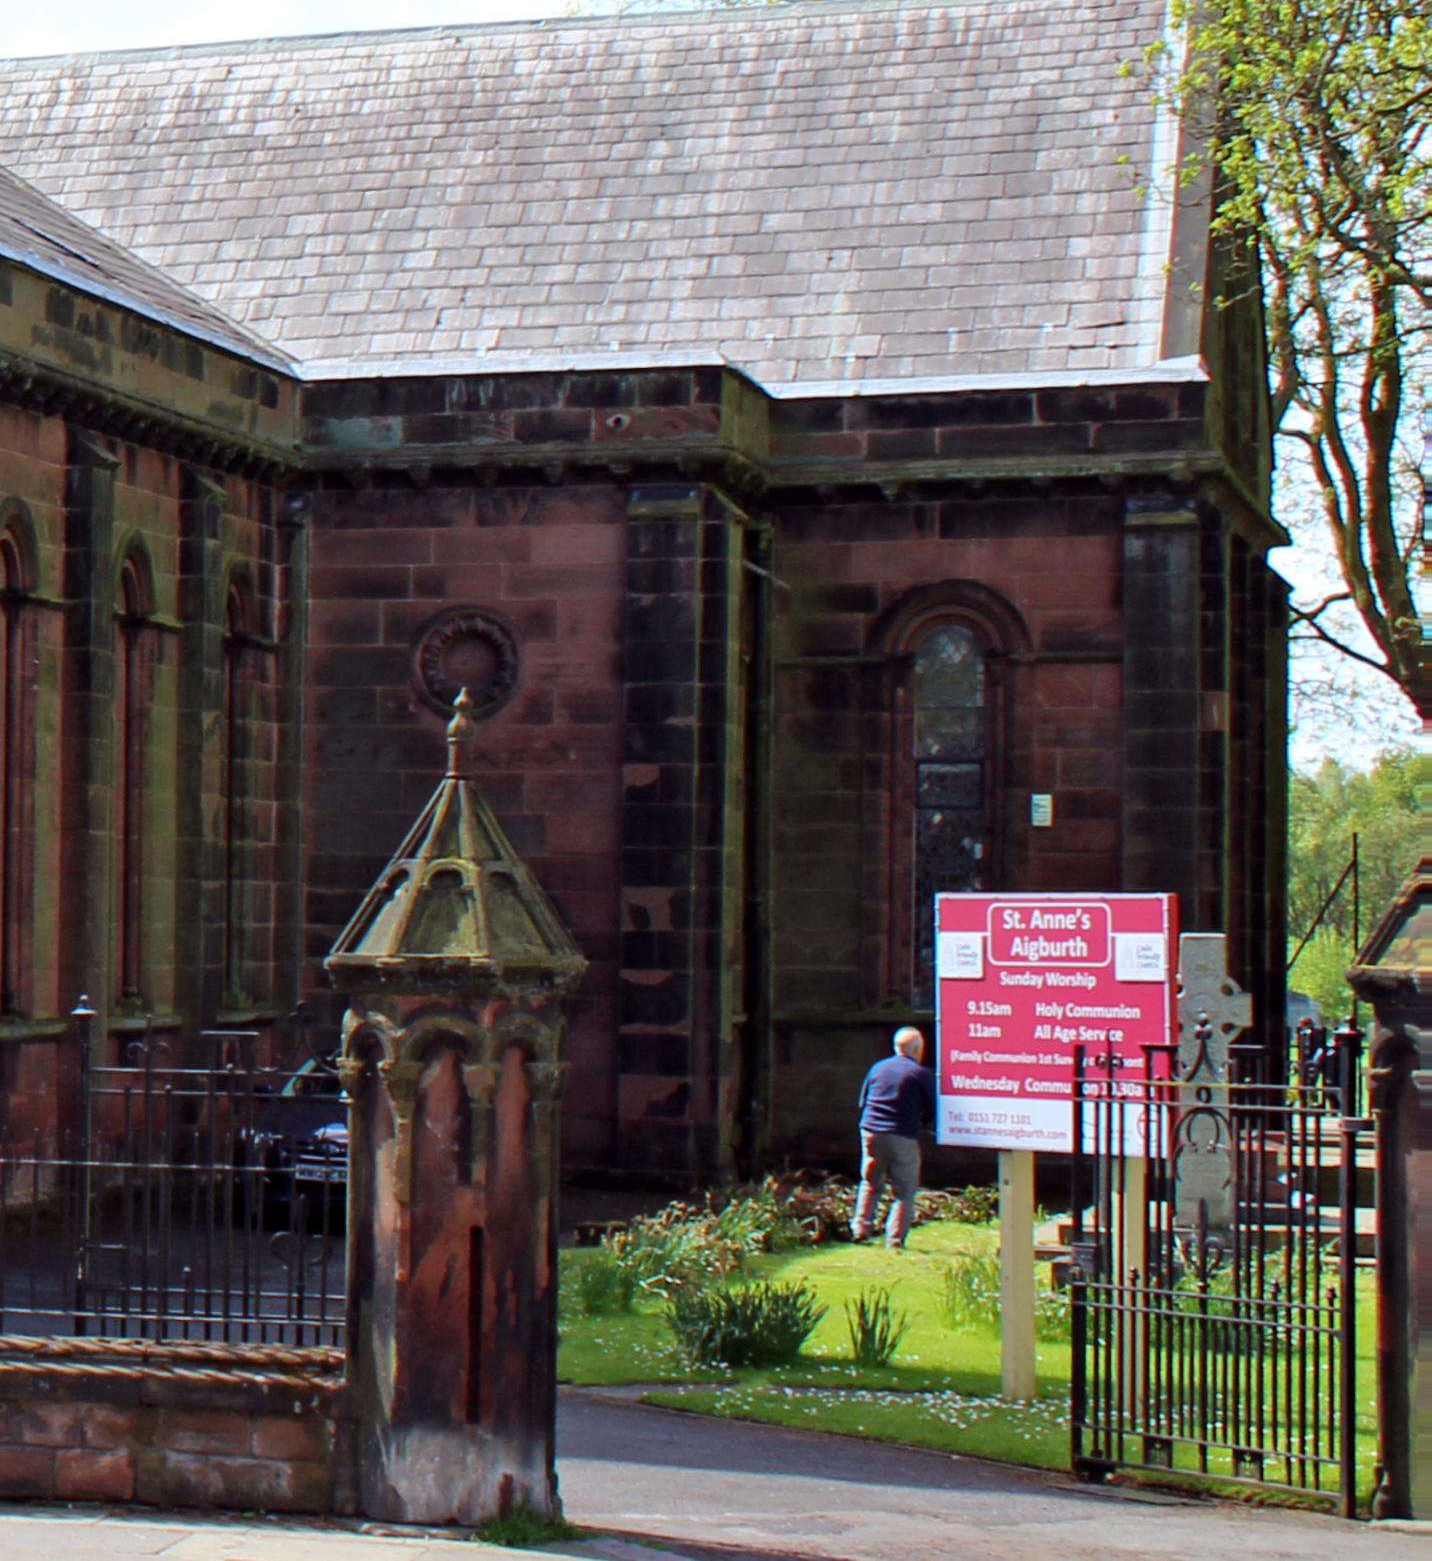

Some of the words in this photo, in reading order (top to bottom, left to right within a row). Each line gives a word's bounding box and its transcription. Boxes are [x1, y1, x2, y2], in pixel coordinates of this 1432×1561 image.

[1003, 909, 1026, 929] St.
[1030, 908, 1091, 930] Anne's
[1010, 936, 1088, 961] Aigburth
[1000, 971, 1044, 988] Sunday
[1045, 972, 1096, 989] Worship
[967, 1000, 1012, 1016] 9.15am
[1035, 1002, 1063, 1020] Holy
[1065, 1003, 1141, 1019] Communion
[968, 1023, 1002, 1038] 11am
[1034, 1025, 1051, 1040] All
[1053, 1026, 1077, 1043] Age
[1078, 1026, 1124, 1042] Servce
[950, 1050, 982, 1064] (Family
[983, 1051, 1037, 1065] Communion
[1038, 1053, 1053, 1065] 1st
[1054, 1054, 1087, 1068] Suny
[951, 1075, 1020, 1094] Wednesday
[1025, 1077, 1099, 1097] Commuon
[968, 1112, 990, 1123] 0151
[992, 1113, 1008, 1124] 727
[949, 1125, 1067, 1140] www.stannesaigburth.com
